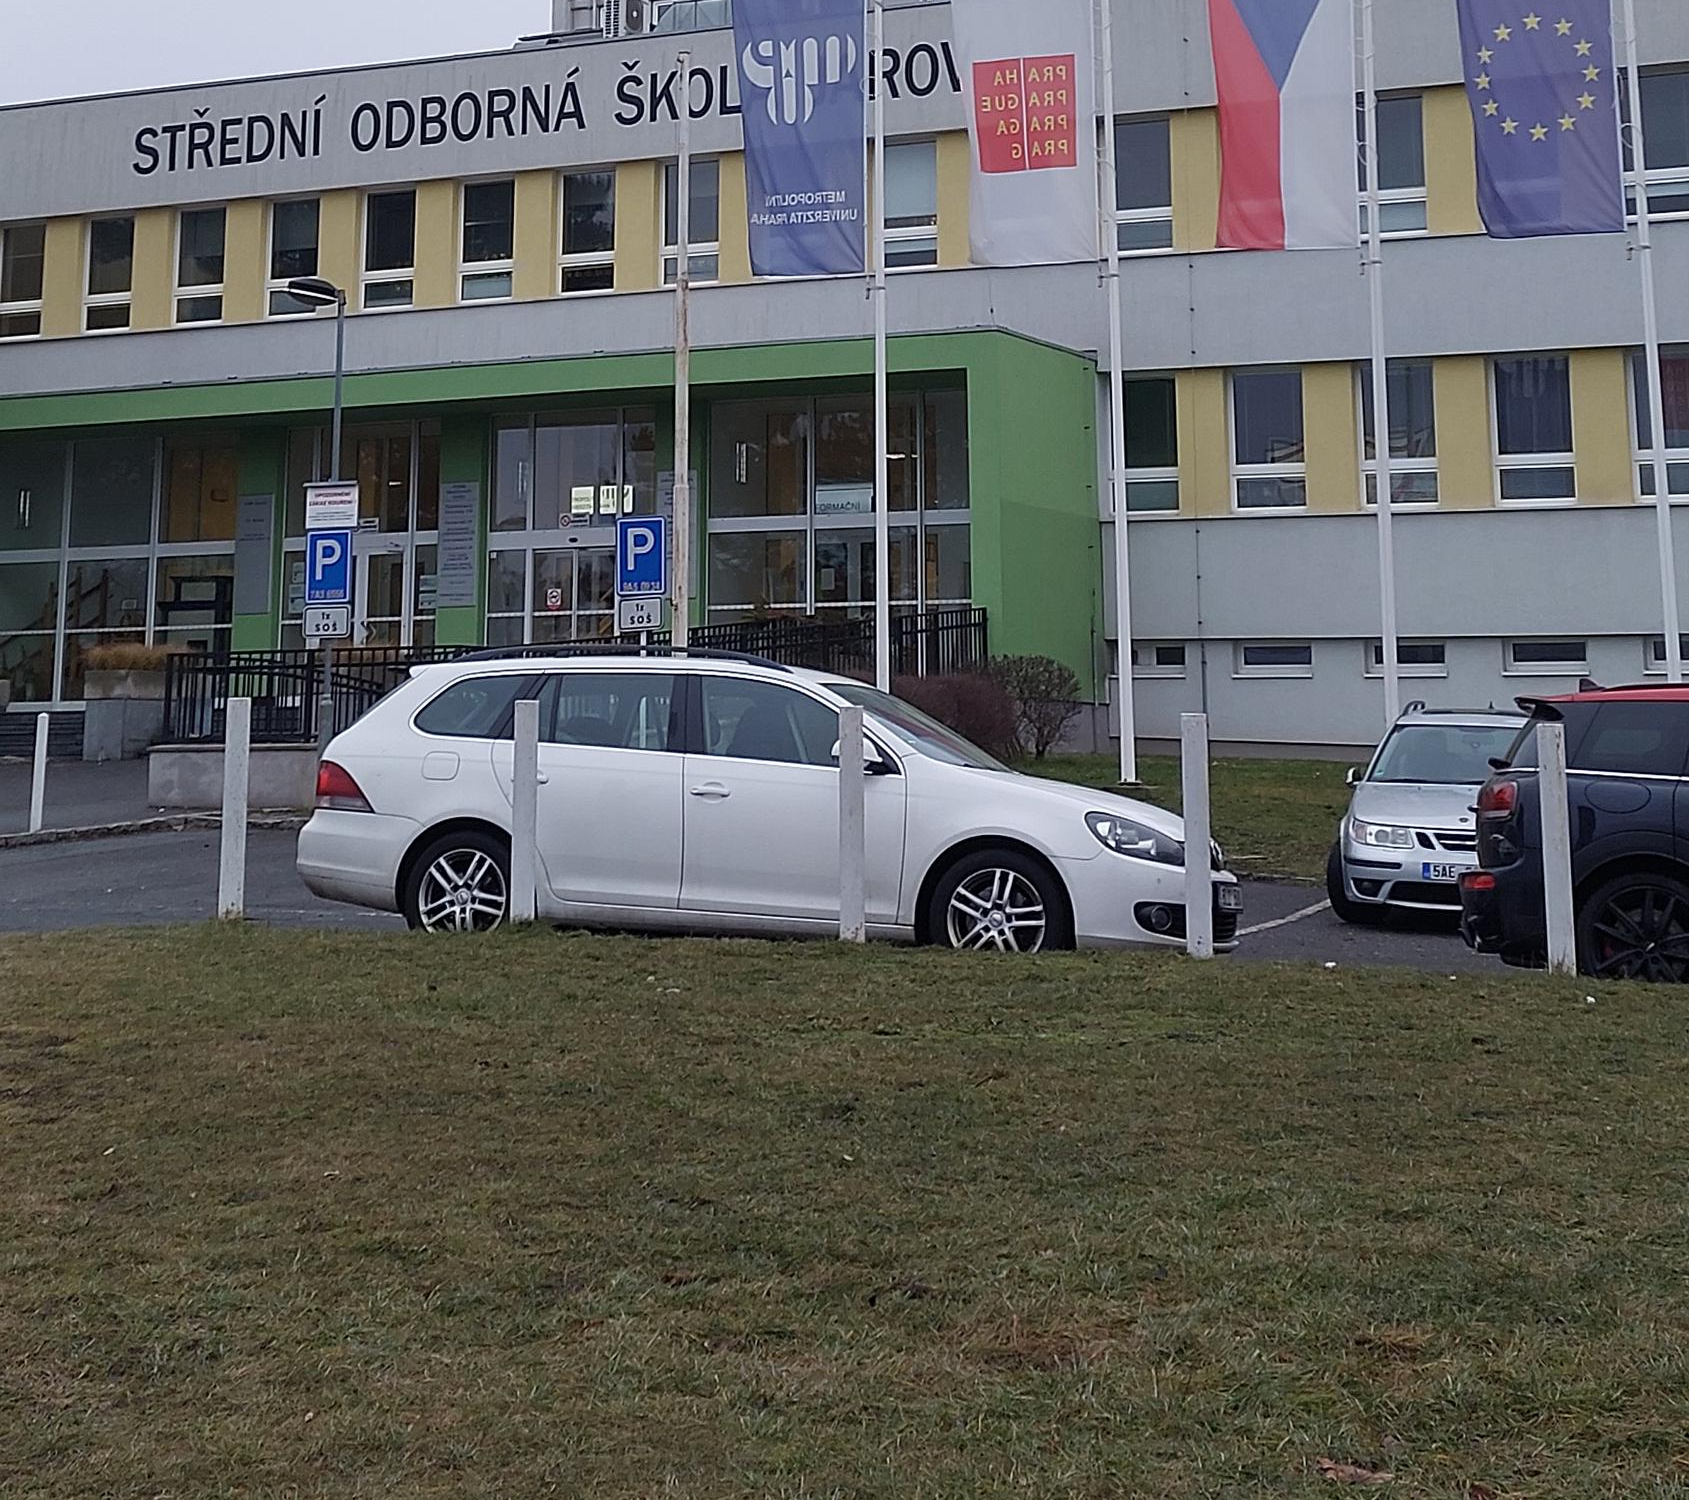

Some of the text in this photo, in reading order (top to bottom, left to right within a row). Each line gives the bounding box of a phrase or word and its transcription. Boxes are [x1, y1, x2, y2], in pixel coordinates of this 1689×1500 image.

[132, 94, 326, 175] STŘEDNÍ
[350, 67, 586, 152] ODBORNÁ
[614, 60, 743, 126] ŠKOL
[315, 539, 341, 581] P
[627, 528, 654, 571] P
[314, 621, 338, 632] SOŠ
[629, 613, 652, 625] SOŠ
[1433, 865, 1456, 878] 5AE
